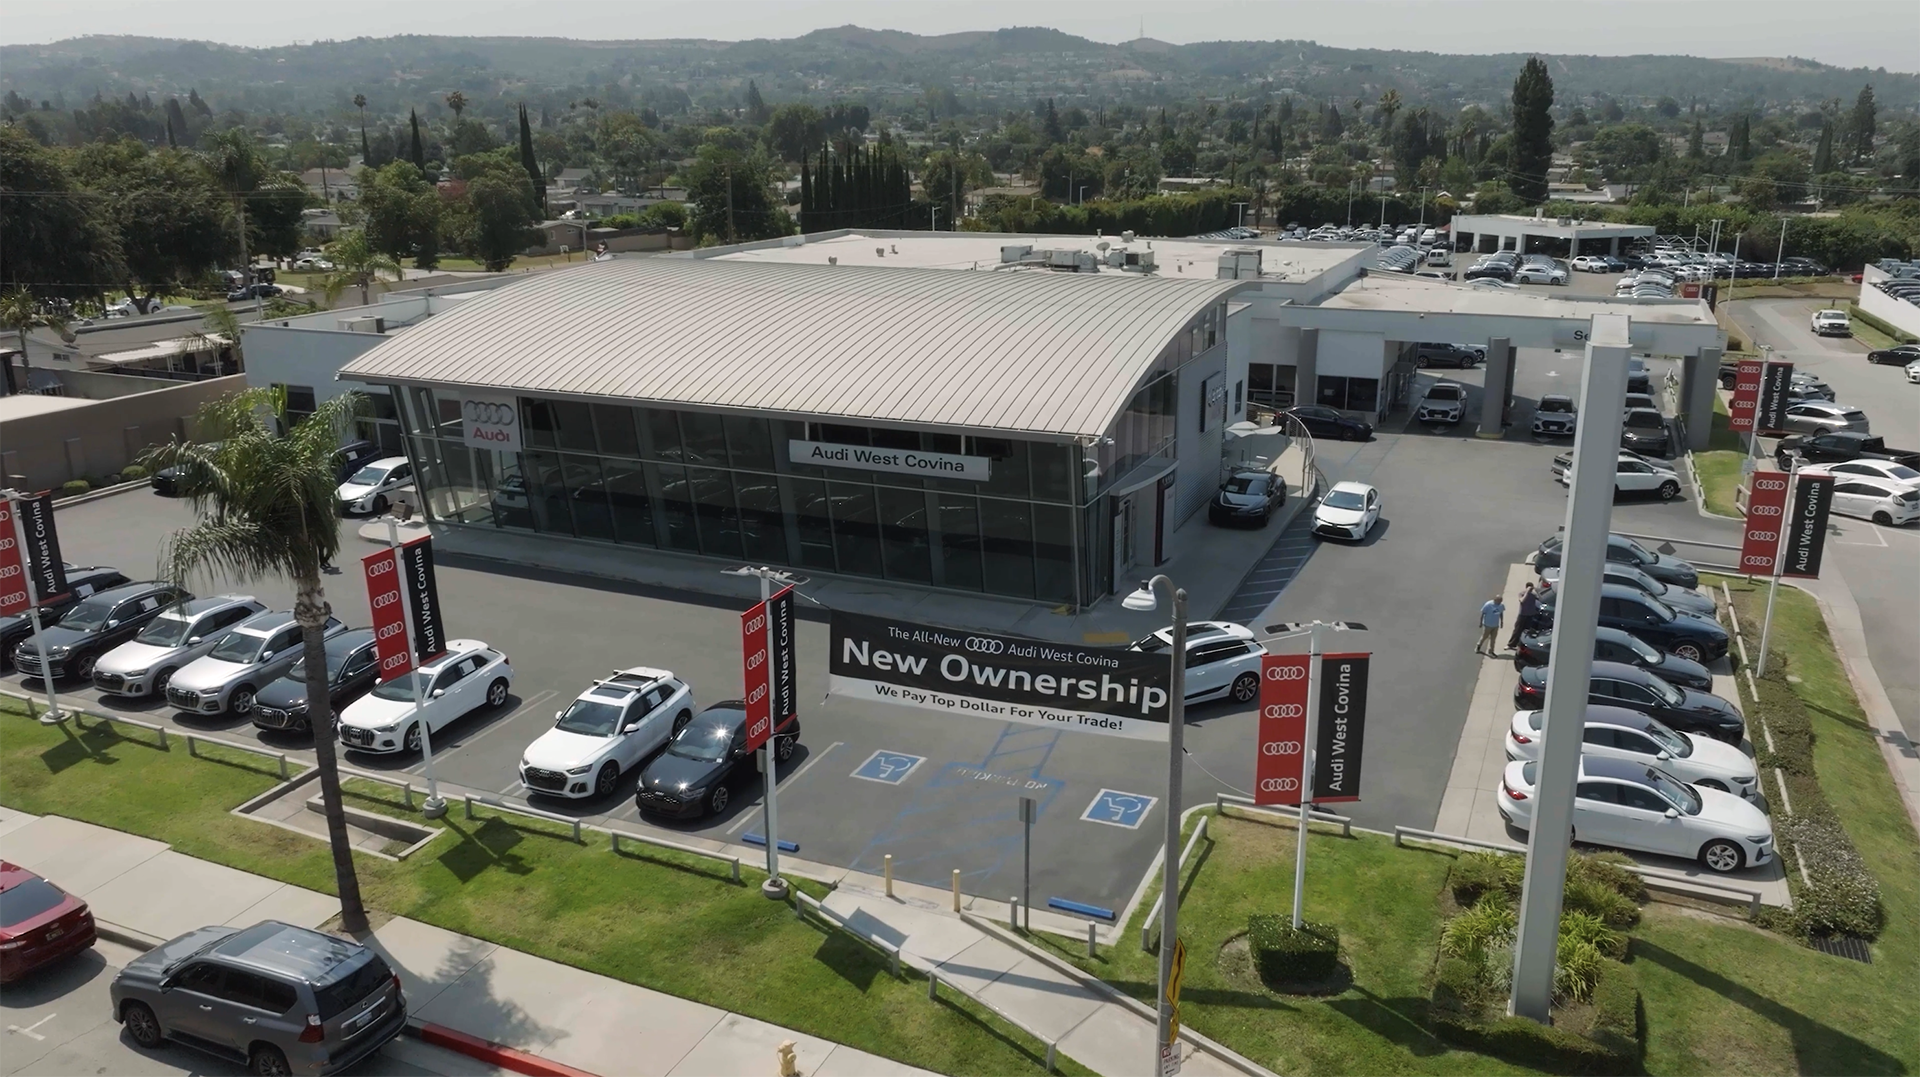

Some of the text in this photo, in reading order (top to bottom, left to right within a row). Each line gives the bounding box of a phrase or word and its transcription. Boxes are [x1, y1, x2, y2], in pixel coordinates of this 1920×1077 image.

[473, 427, 510, 442] Audi
[1767, 367, 1784, 428] Audi West Covina
[811, 446, 965, 472] Audi West Covina
[32, 501, 57, 593] Audi West Covina
[1796, 482, 1820, 571] Audi West Covina
[414, 547, 436, 653] Audi West Covina
[779, 600, 790, 716] Audi West Covina
[843, 638, 1168, 714] New Ownership
[888, 626, 1119, 668] The All-New Audi West Covina
[875, 684, 1123, 731] We Pay Top Dollar For Your Trade!
[1329, 664, 1351, 792] Audi West Covina
